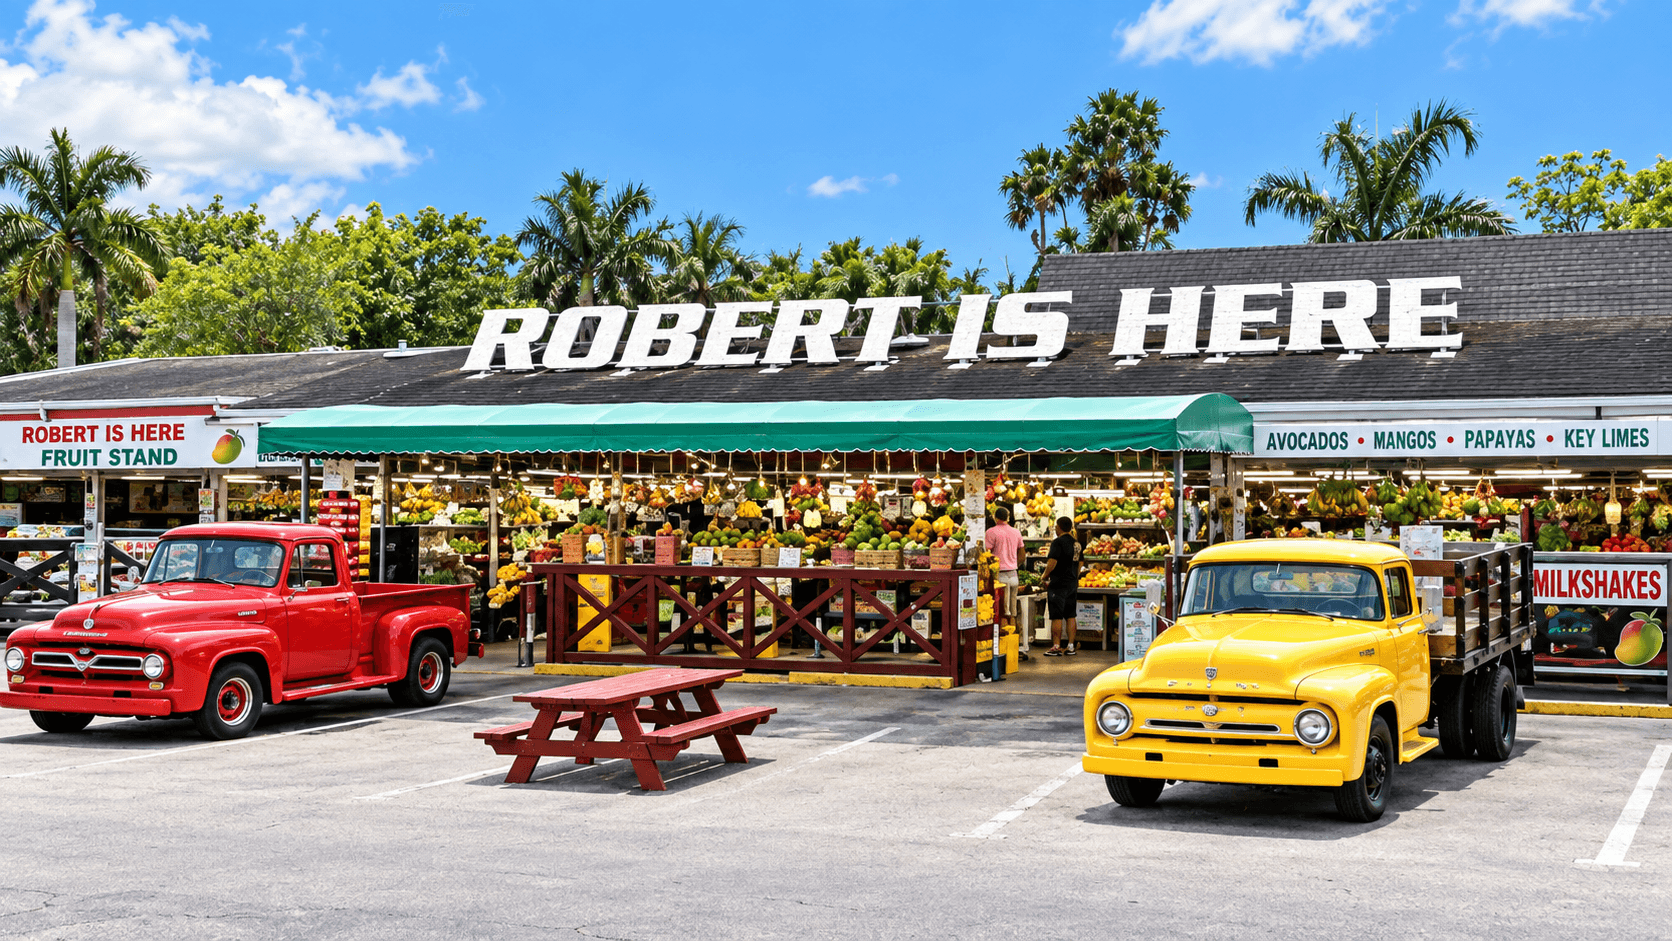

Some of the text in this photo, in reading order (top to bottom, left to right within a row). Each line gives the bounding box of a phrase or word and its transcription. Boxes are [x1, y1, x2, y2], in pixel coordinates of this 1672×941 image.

[459, 275, 1463, 371] ROBERT IS HERE
[22, 423, 185, 444] ROBERT IS HERE
[1266, 427, 1650, 451] AVOCADOS MANGOS PAPAYAS KEY LIMES
[41, 448, 178, 467] FRUIT STAND
[1533, 569, 1662, 600] MILKSHAKES
